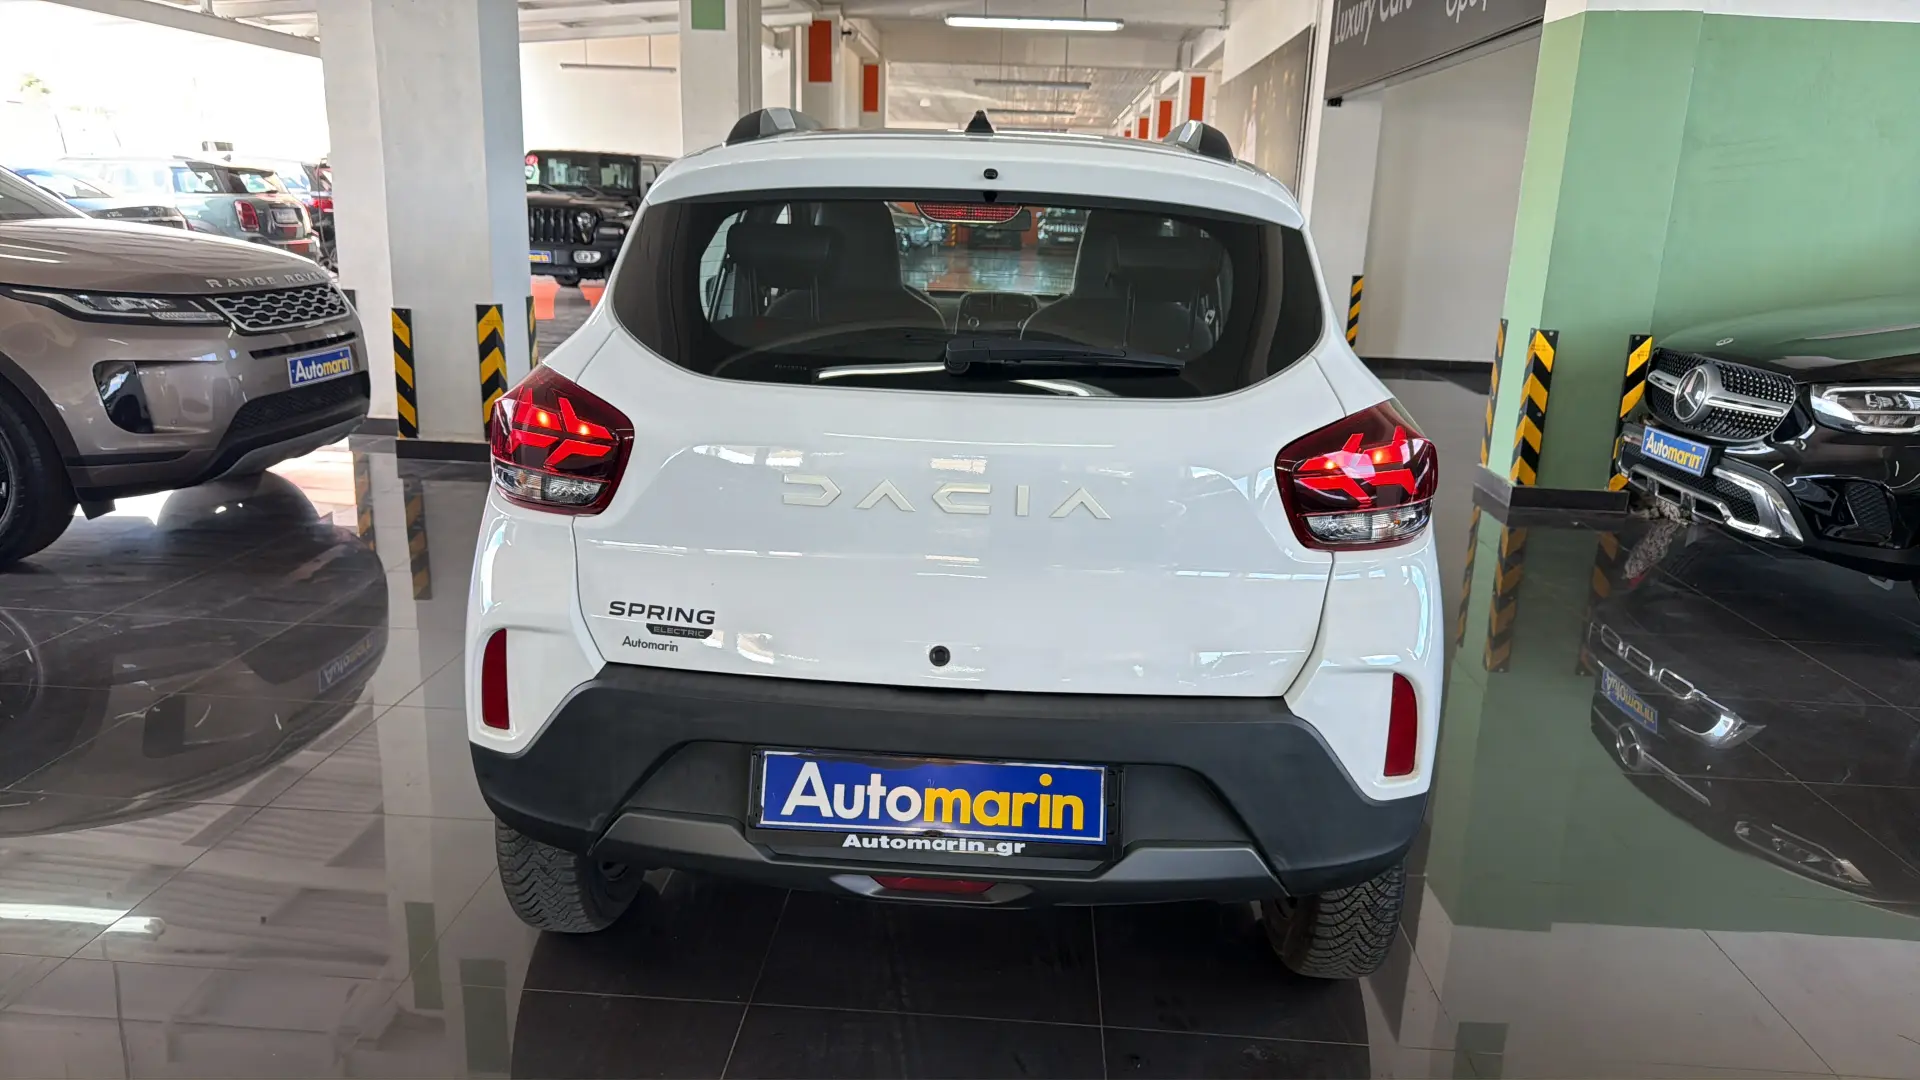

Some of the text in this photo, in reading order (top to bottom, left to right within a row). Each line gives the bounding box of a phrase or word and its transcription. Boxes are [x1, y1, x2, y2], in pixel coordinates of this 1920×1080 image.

[1334, 0, 1376, 46] Luxury
[206, 277, 276, 291] RANGE
[295, 352, 350, 382] Automarin
[1645, 432, 1701, 469] Automarin
[783, 474, 1111, 519] DACIA
[609, 601, 716, 625] SPRING
[622, 635, 679, 652] Automarin
[653, 626, 705, 637] ELECTRIC
[780, 761, 1084, 831] Automarin
[842, 834, 1026, 857] Automarin.gr
